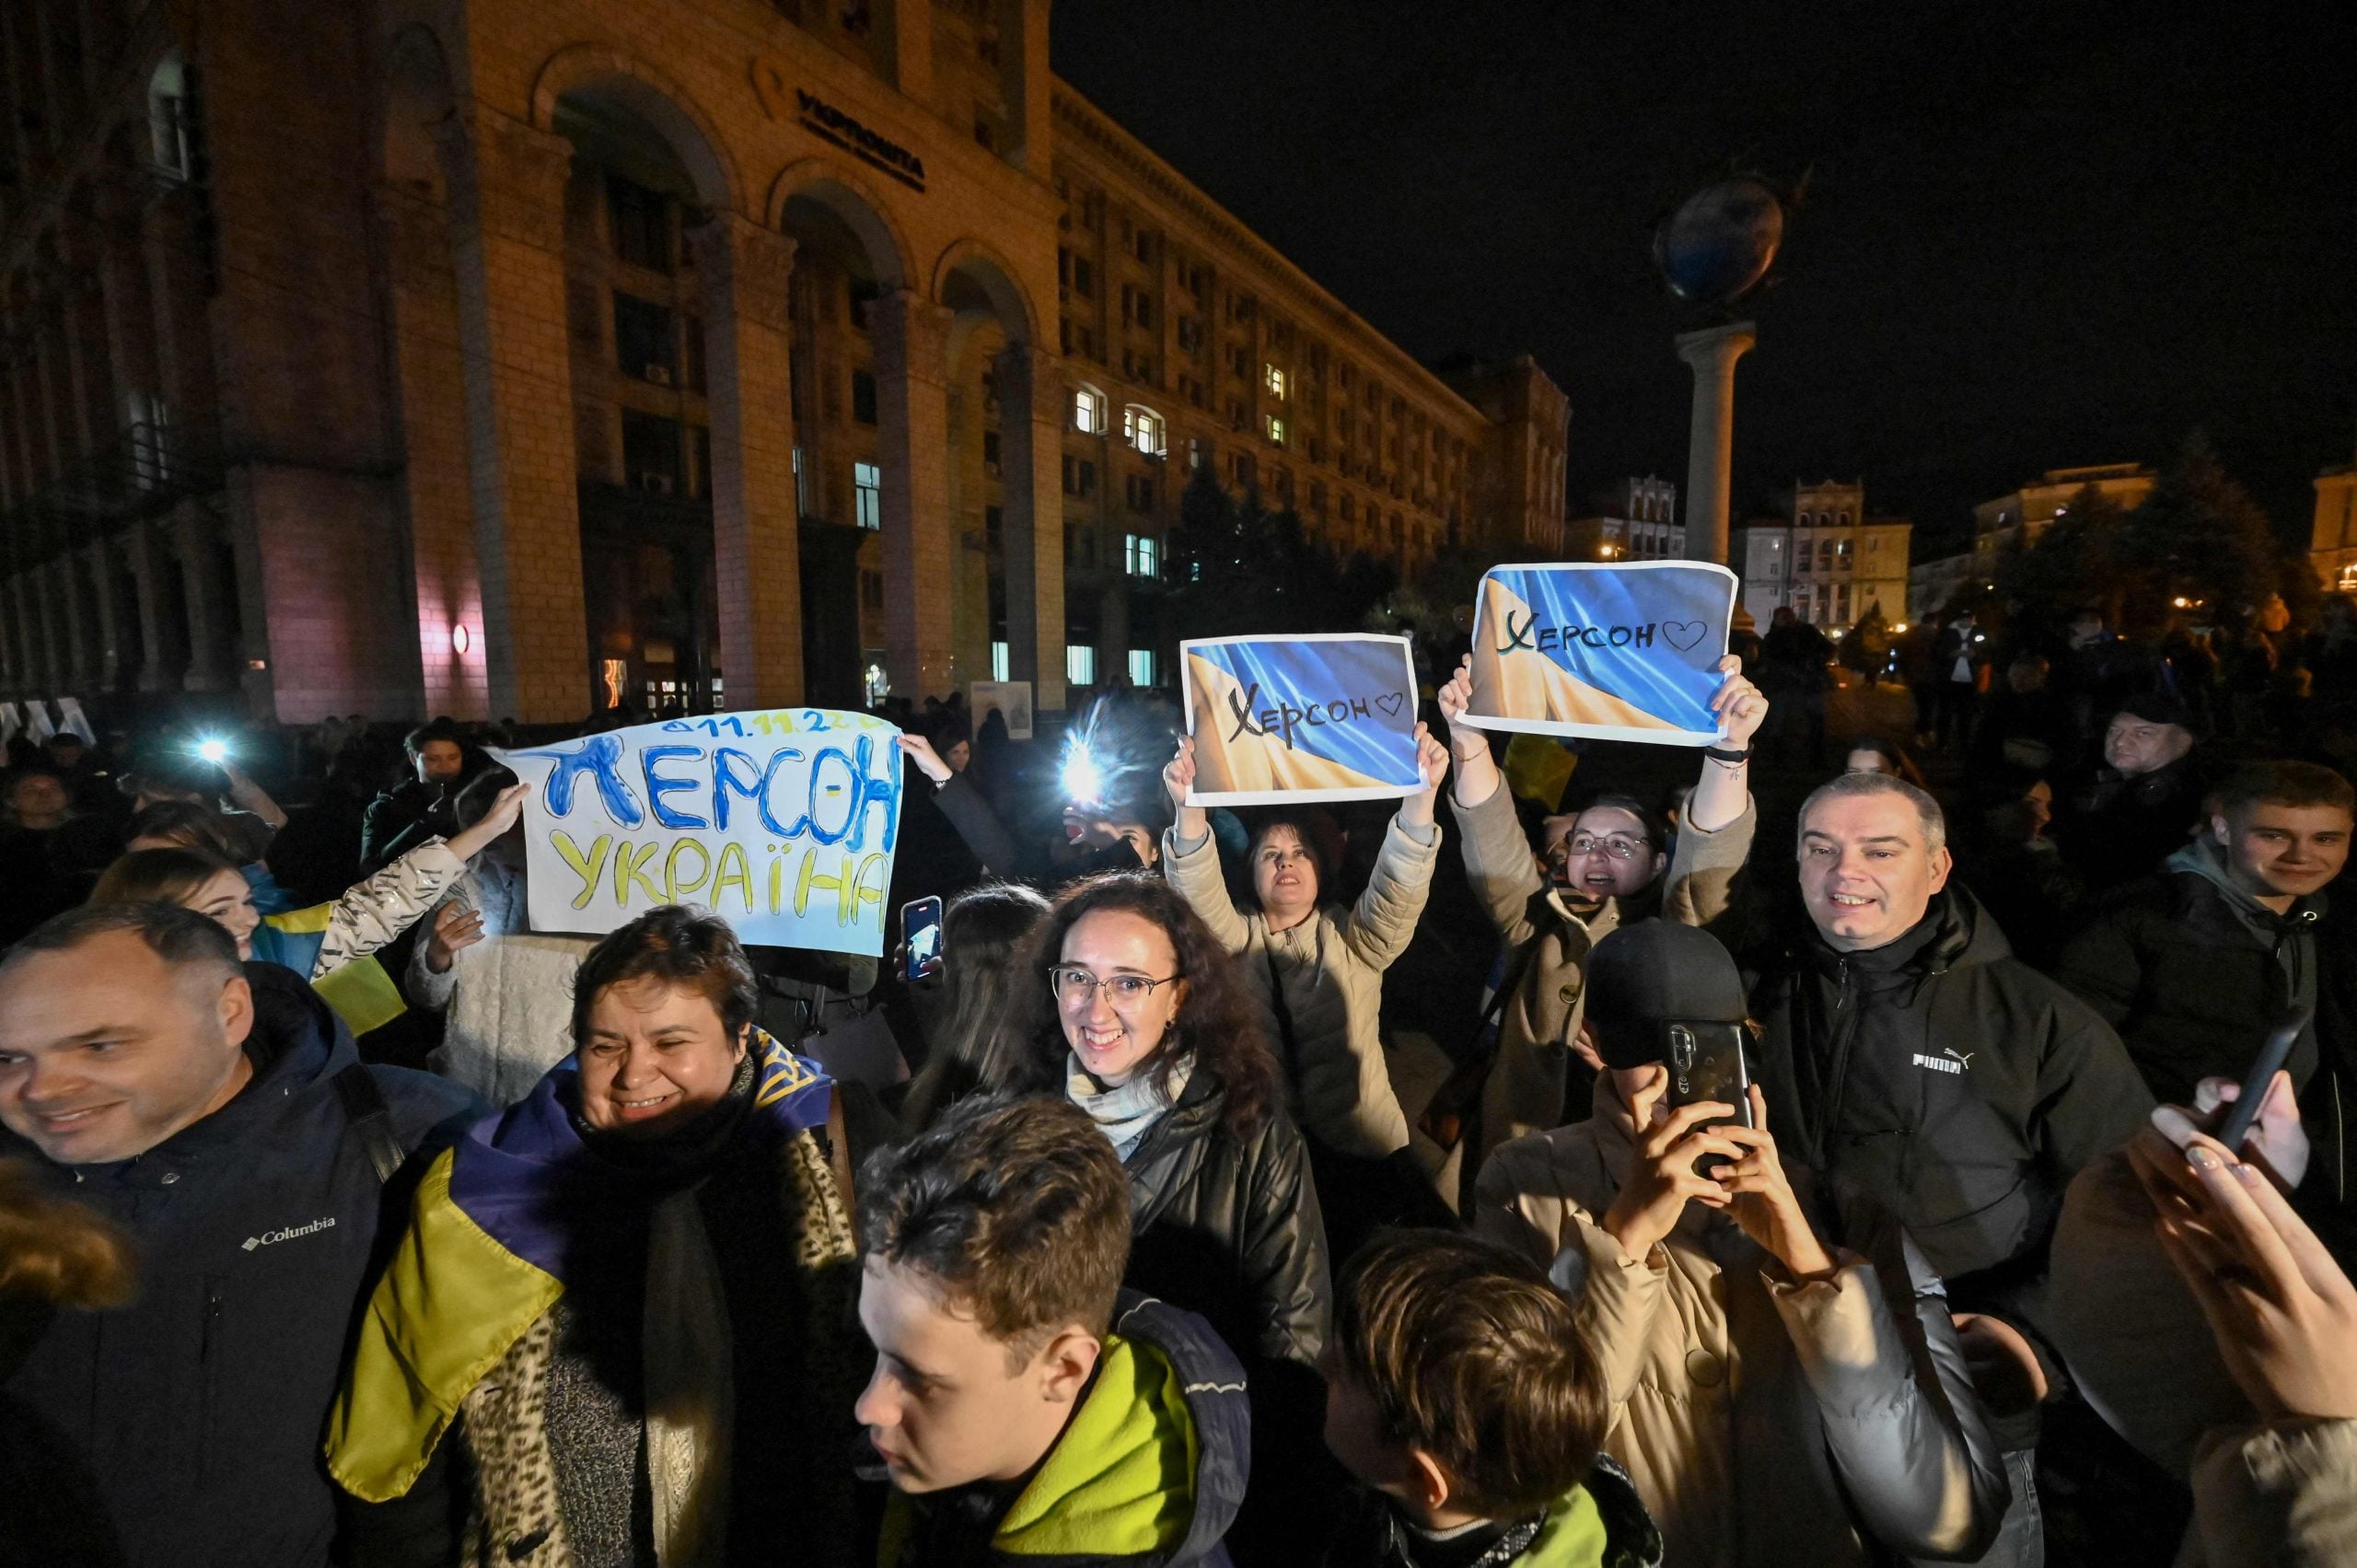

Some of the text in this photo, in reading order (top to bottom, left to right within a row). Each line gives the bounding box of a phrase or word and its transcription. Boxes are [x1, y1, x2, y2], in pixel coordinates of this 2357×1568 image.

[549, 830, 889, 934] УКРАЇНА
[1912, 1052, 1962, 1075] PUMA
[261, 1216, 336, 1245] Columbia
